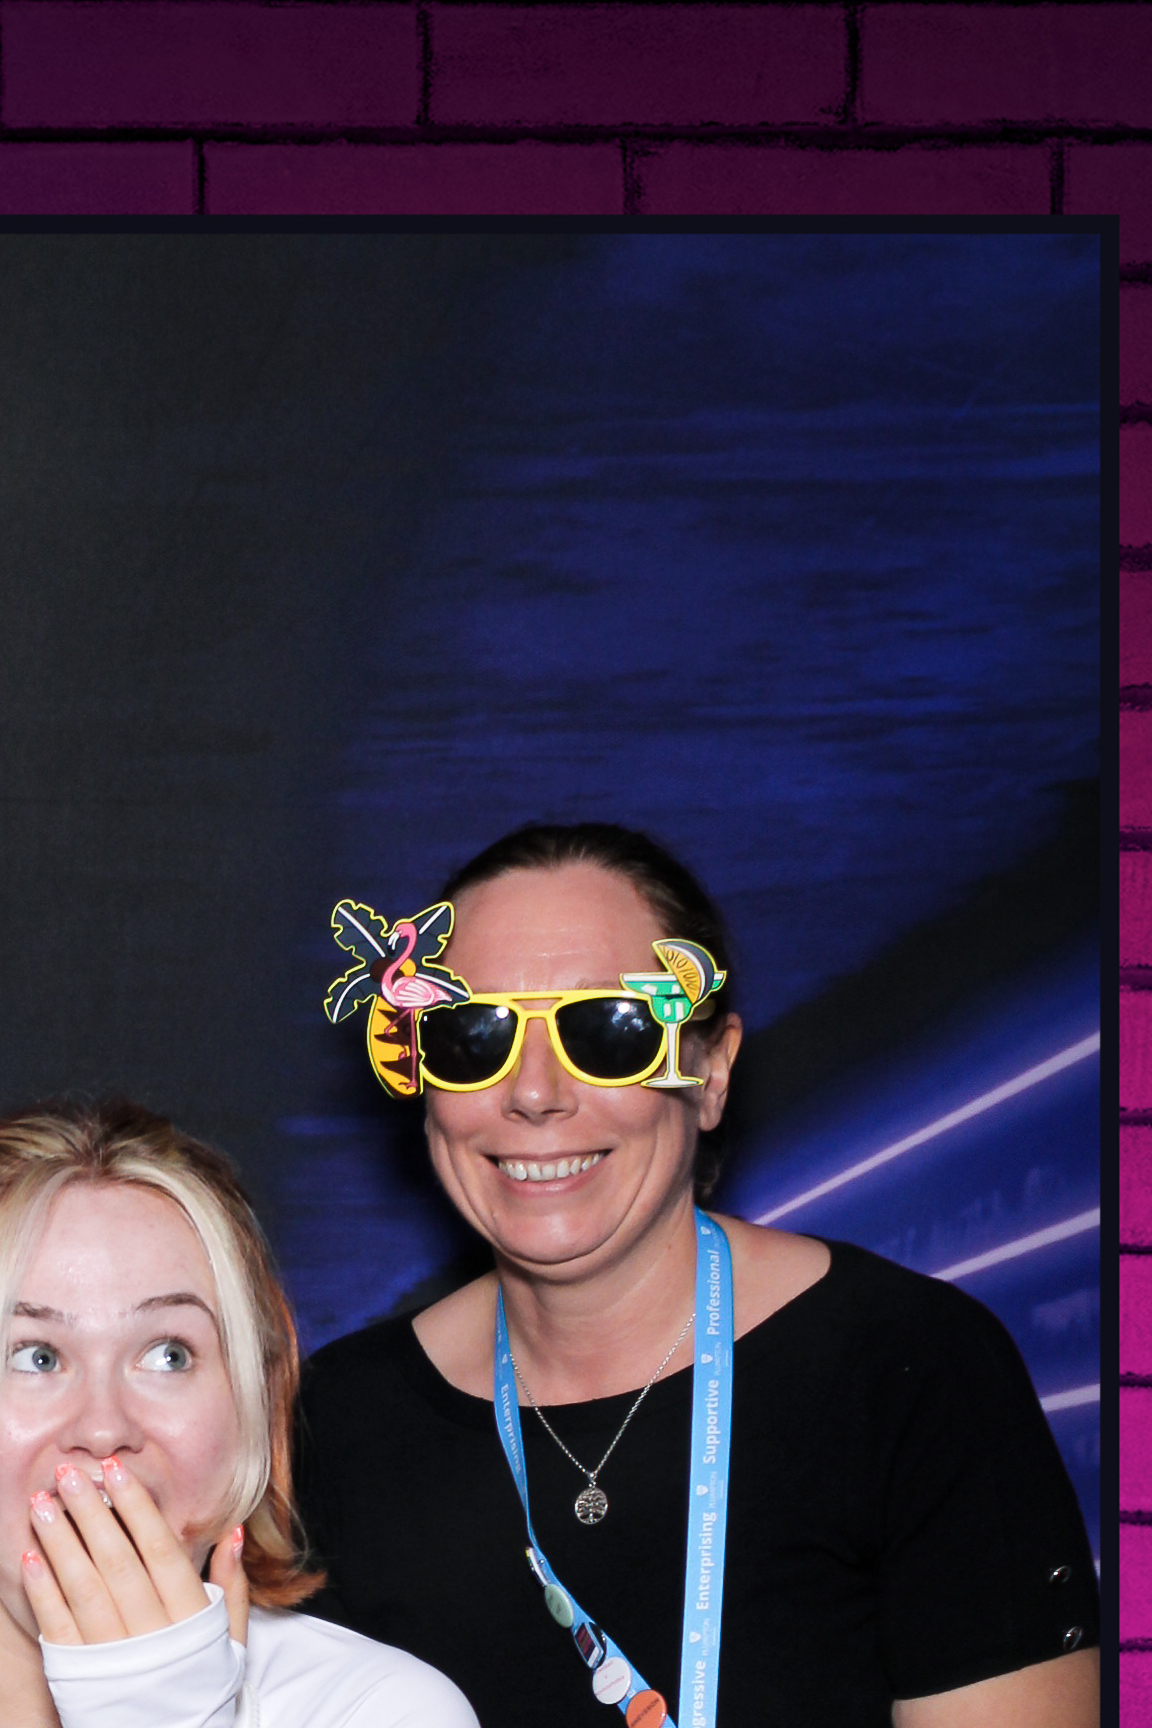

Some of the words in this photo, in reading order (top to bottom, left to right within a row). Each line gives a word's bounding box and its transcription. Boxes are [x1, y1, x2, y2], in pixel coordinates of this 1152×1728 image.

[706, 1249, 721, 1336] Professional
[500, 1383, 522, 1474] Enterprising
[703, 1379, 722, 1465] Supportive
[696, 1512, 718, 1610] Enterprising
